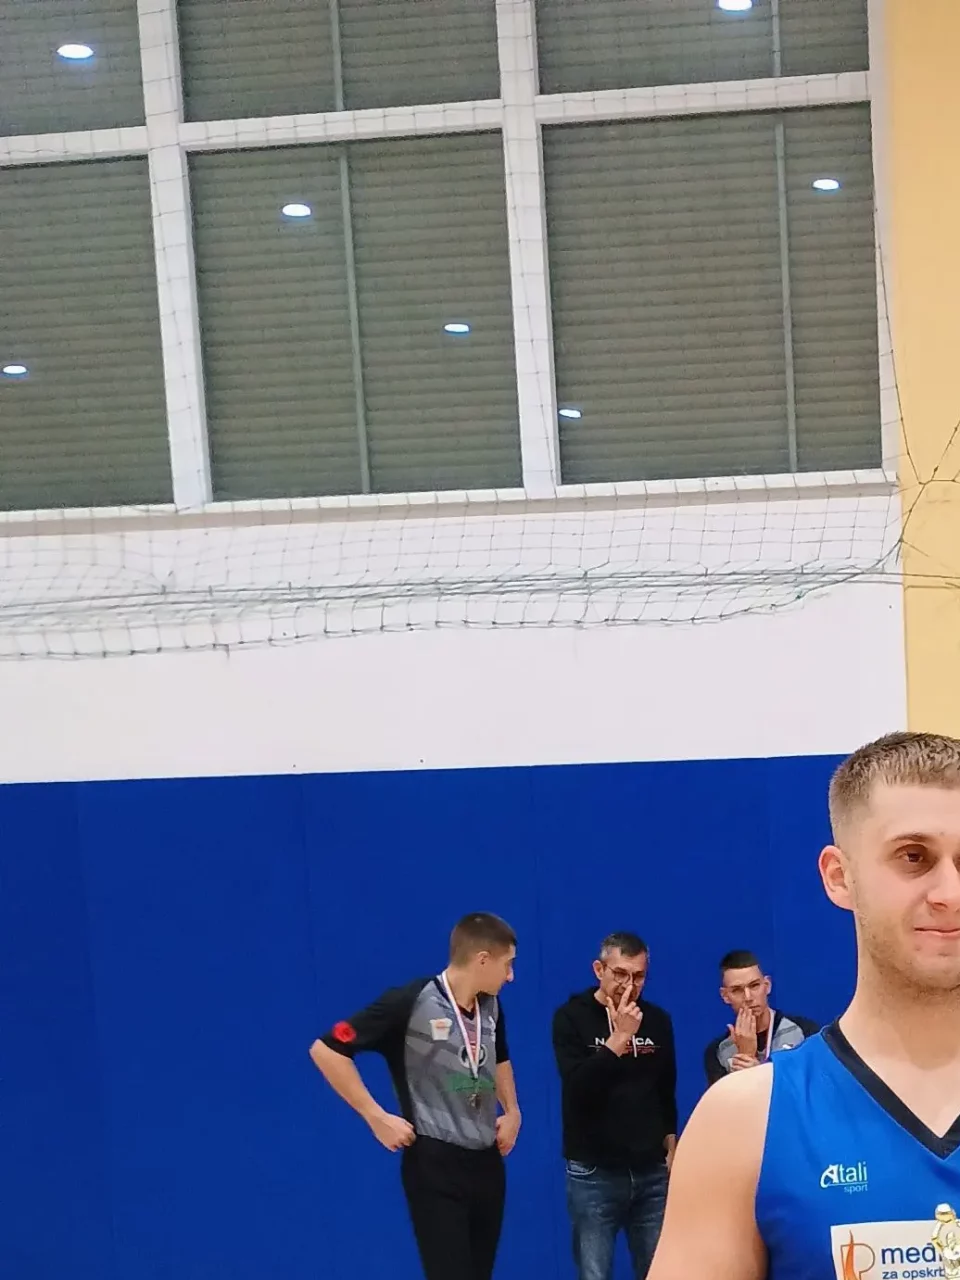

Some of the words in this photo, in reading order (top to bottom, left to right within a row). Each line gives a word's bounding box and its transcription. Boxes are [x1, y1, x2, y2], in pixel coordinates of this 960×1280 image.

[820, 1161, 868, 1188] Atali
[843, 1184, 868, 1195] sport
[882, 1271, 898, 1280] za
